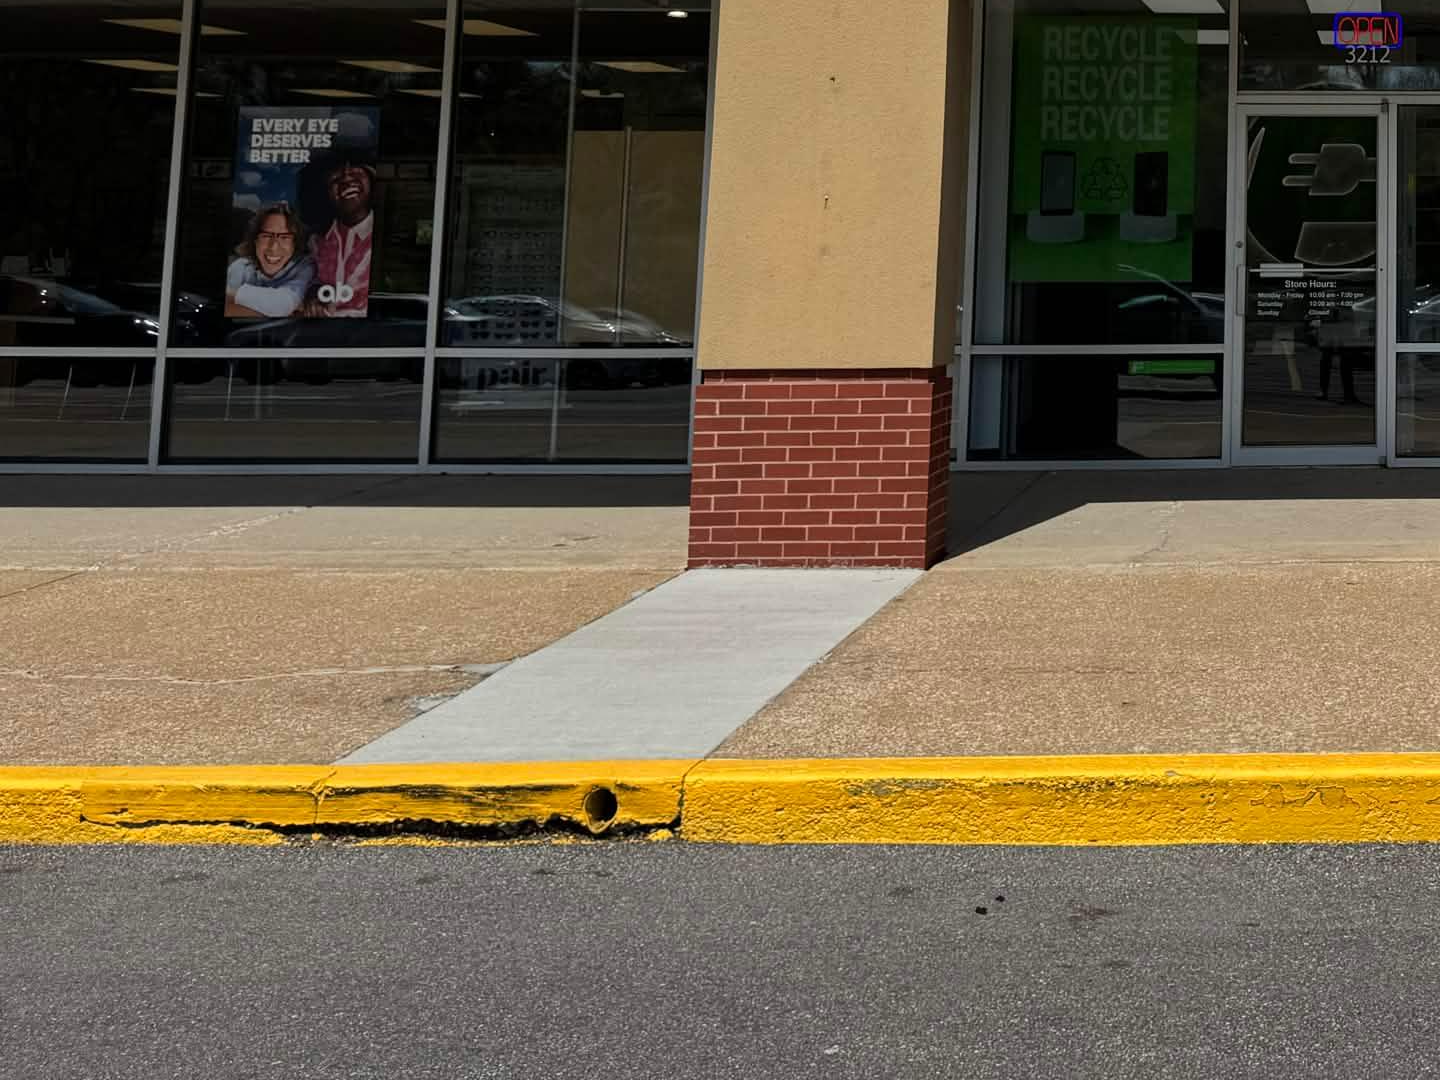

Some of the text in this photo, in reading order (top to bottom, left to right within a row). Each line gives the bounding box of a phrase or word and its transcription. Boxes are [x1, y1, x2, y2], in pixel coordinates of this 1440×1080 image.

[1338, 16, 1399, 45] OPEN
[1042, 25, 1173, 62] RECYCLE
[1344, 45, 1392, 64] 3212
[1042, 65, 1172, 102] RECYCLE
[252, 118, 339, 133] EVERY EYE
[1040, 105, 1171, 141] RECYCLE
[250, 134, 333, 148] DESERVES
[249, 149, 311, 164] BETTER
[1284, 279, 1337, 288] Store Hours:
